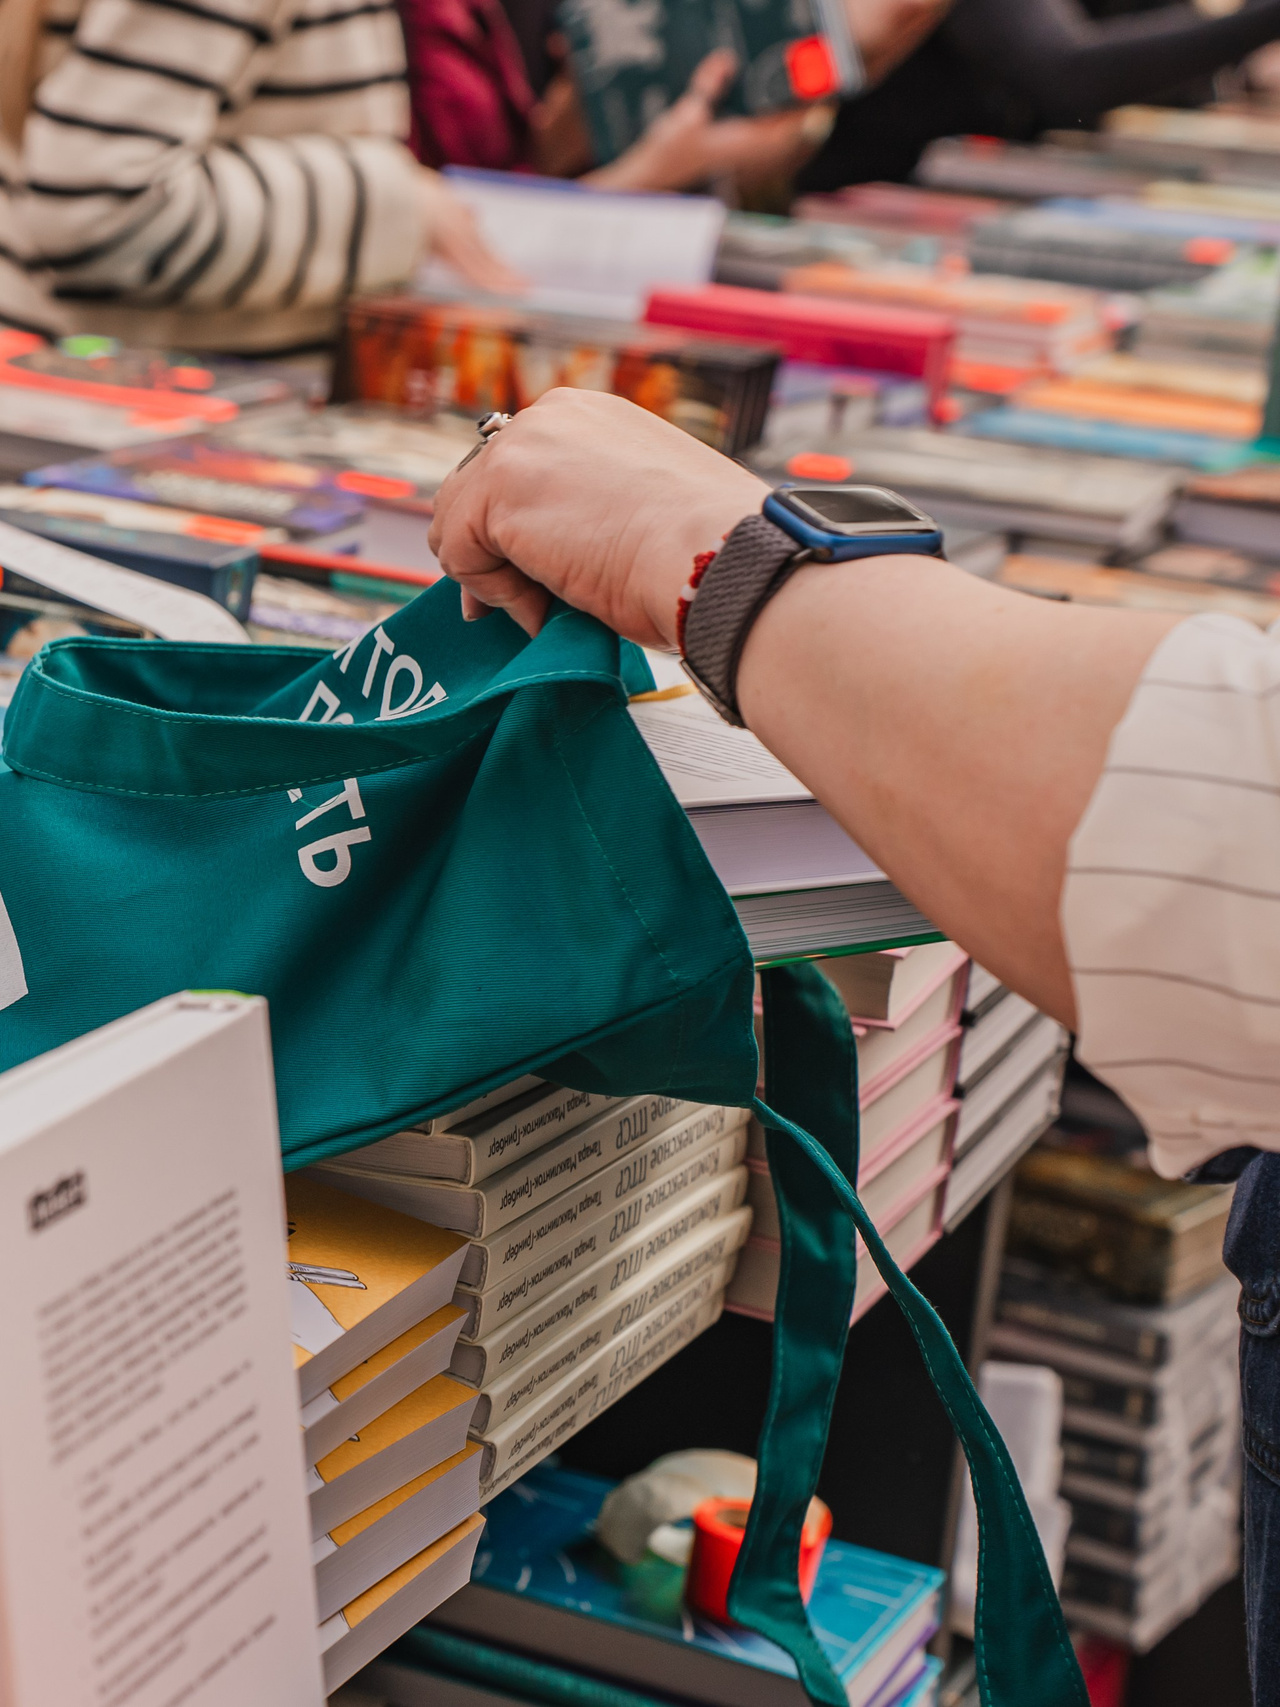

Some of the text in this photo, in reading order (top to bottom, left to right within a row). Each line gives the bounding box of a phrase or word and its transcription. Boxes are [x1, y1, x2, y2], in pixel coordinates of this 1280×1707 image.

[487, 1103, 566, 1158] Макклинток-Гринберг
[615, 1105, 649, 1150] ПТСР
[499, 1140, 602, 1210] Тамара Макклинток-Гринберг
[615, 1154, 648, 1199] ПТСР
[502, 1190, 602, 1265] Тамара Макклинток-Гринберг
[609, 1199, 642, 1243] ПТСР
[497, 1234, 596, 1312] Тамара Макклинток-Гринберг
[610, 1247, 644, 1291] ПТСР
[499, 1284, 597, 1364] Тамара Макклинток-Гринберг
[612, 1291, 648, 1335] ПТСР
[609, 1332, 642, 1378] ПТСР
